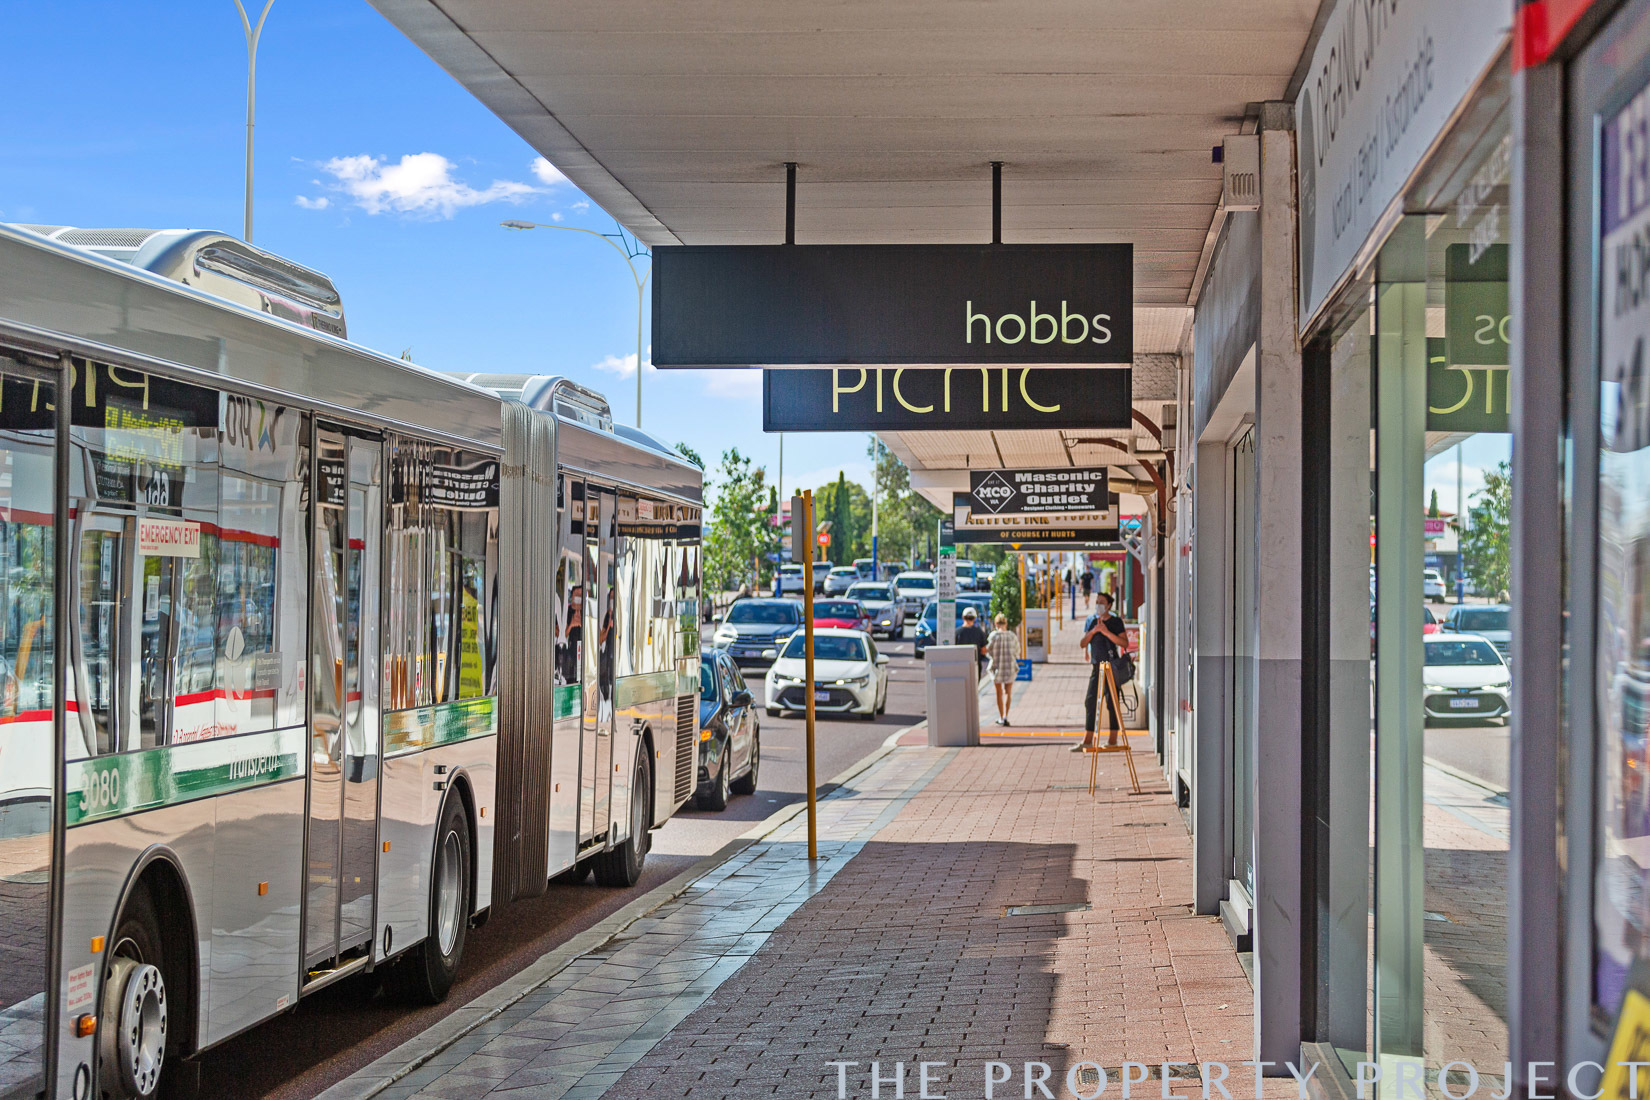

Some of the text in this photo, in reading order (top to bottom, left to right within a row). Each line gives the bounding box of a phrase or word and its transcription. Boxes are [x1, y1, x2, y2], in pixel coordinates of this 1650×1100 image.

[966, 300, 1112, 345] hobbs
[1015, 471, 1103, 483] Masonic
[978, 486, 1011, 499] MCO
[1020, 483, 1096, 495] Charity
[1026, 494, 1089, 505] Outlet
[140, 524, 199, 546] EMERGENCY EXIT
[1000, 531, 1009, 539] OF
[1051, 530, 1076, 538] HURTS
[80, 768, 120, 811] 3080
